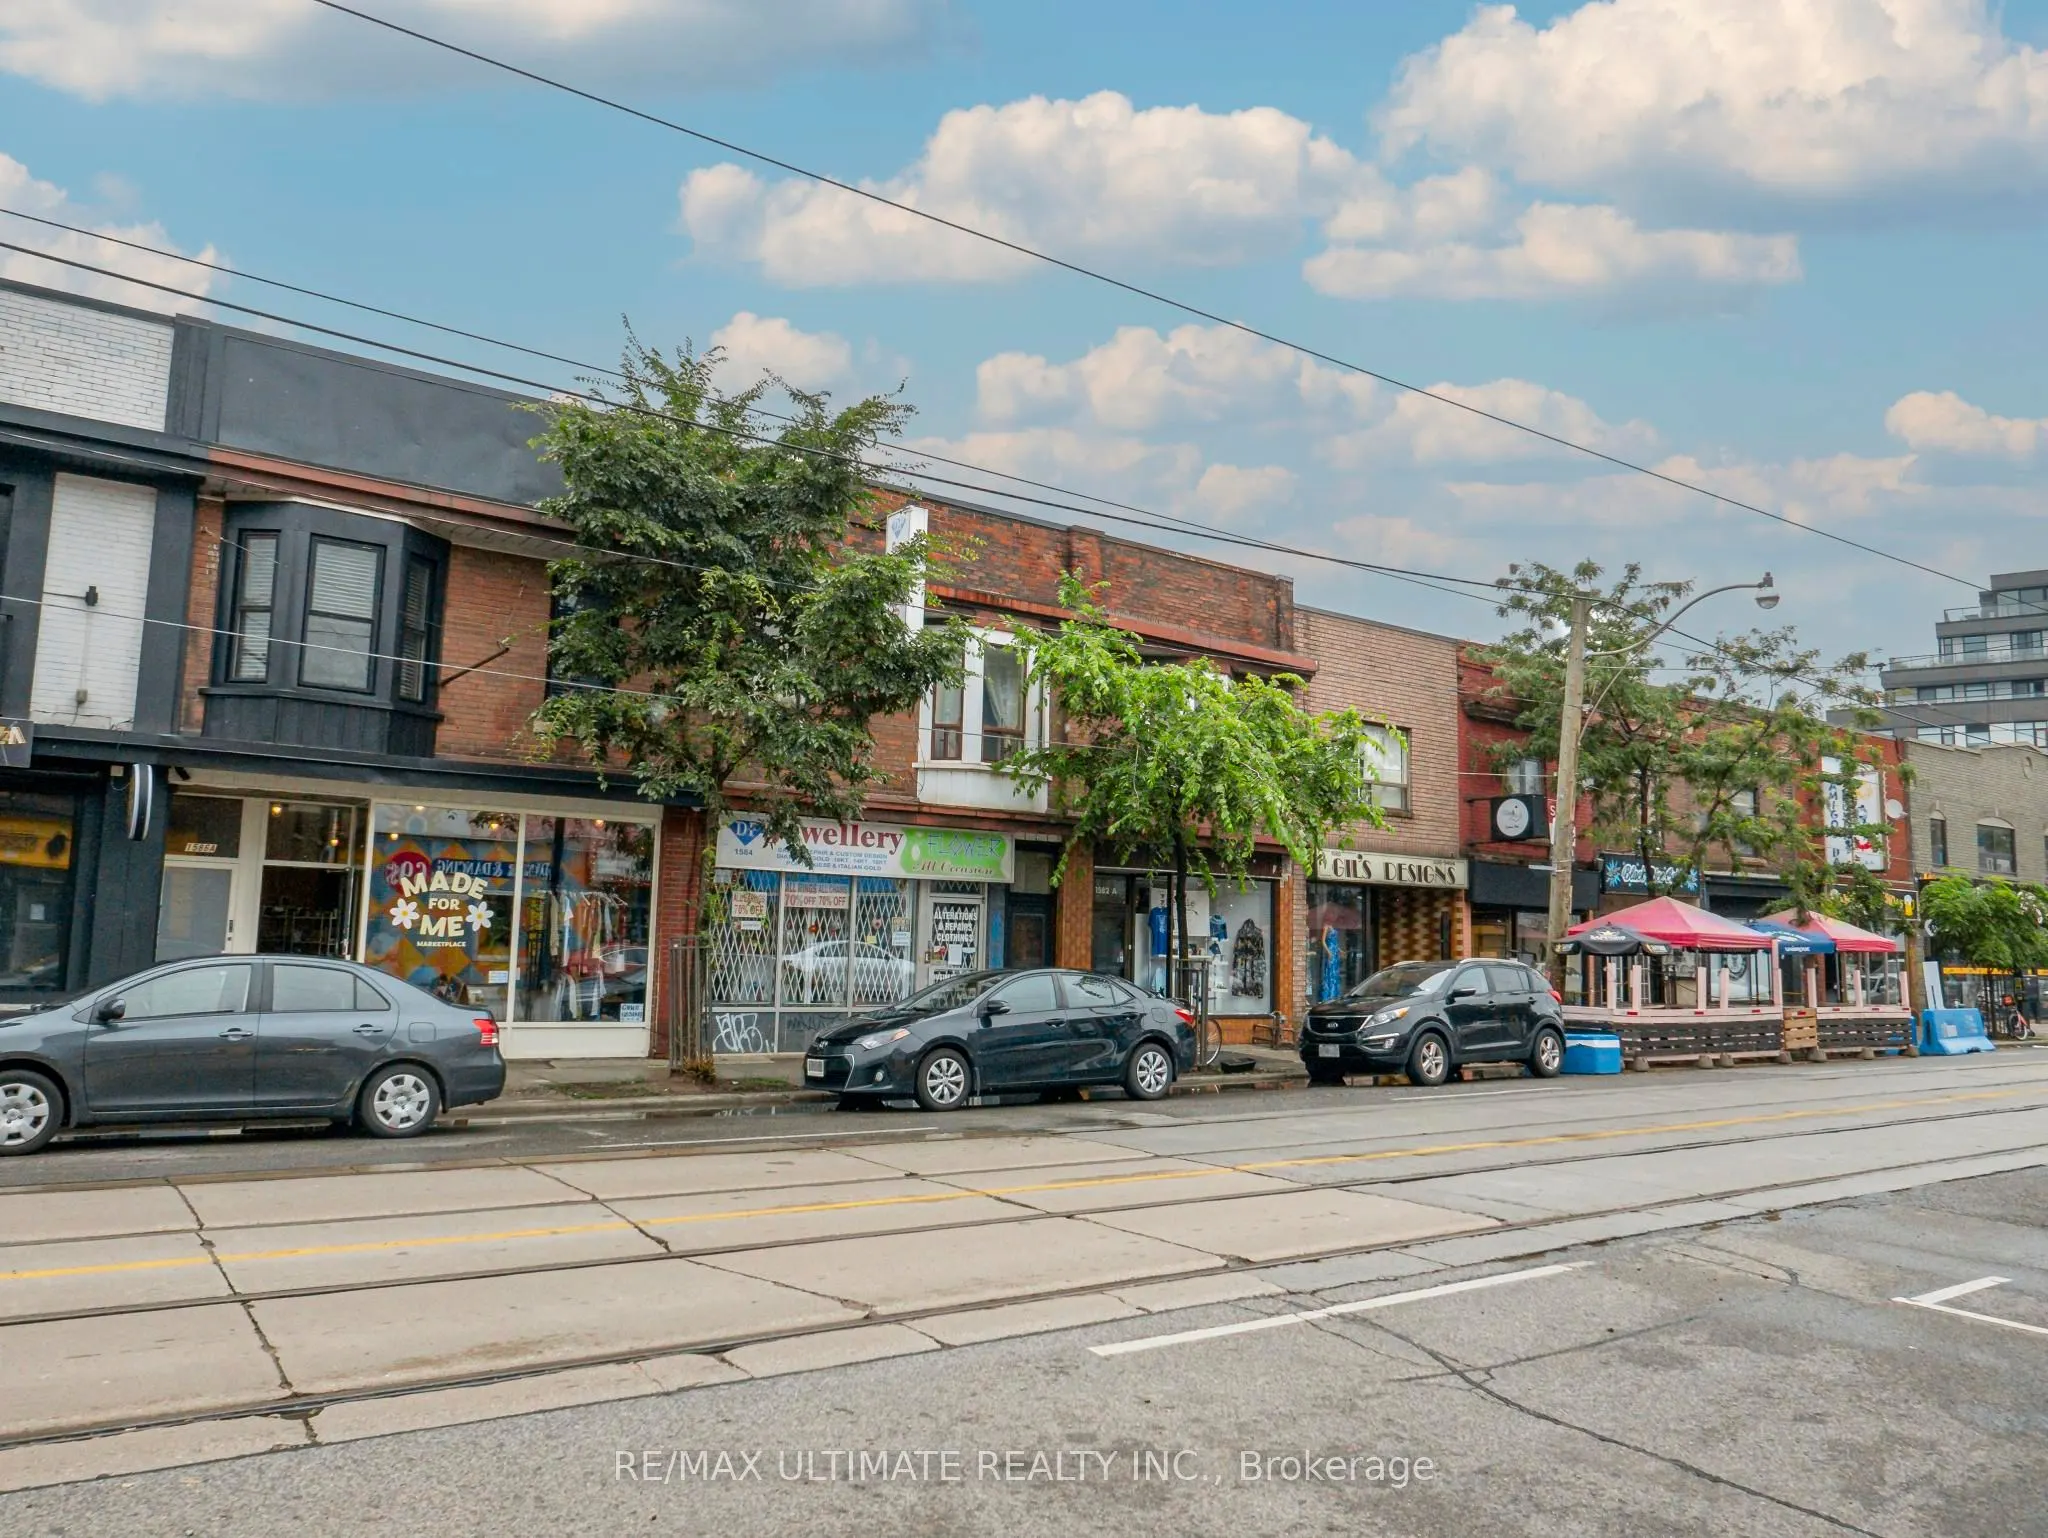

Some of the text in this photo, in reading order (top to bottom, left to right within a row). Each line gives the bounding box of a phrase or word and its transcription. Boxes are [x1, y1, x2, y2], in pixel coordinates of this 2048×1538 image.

[927, 832, 1001, 857] FLOWER
[1332, 853, 1456, 886] GIL'S DESIGNS
[400, 870, 488, 900] MADE
[428, 897, 461, 911] FOR
[803, 895, 817, 905] OFF
[833, 896, 847, 906] OFF
[934, 911, 977, 921] ALTERATIONS
[419, 914, 465, 938] ME
[944, 922, 973, 932] REPAIRS
[937, 933, 974, 942] CLOTHINGS
[416, 940, 467, 948] MARKETPLACE
